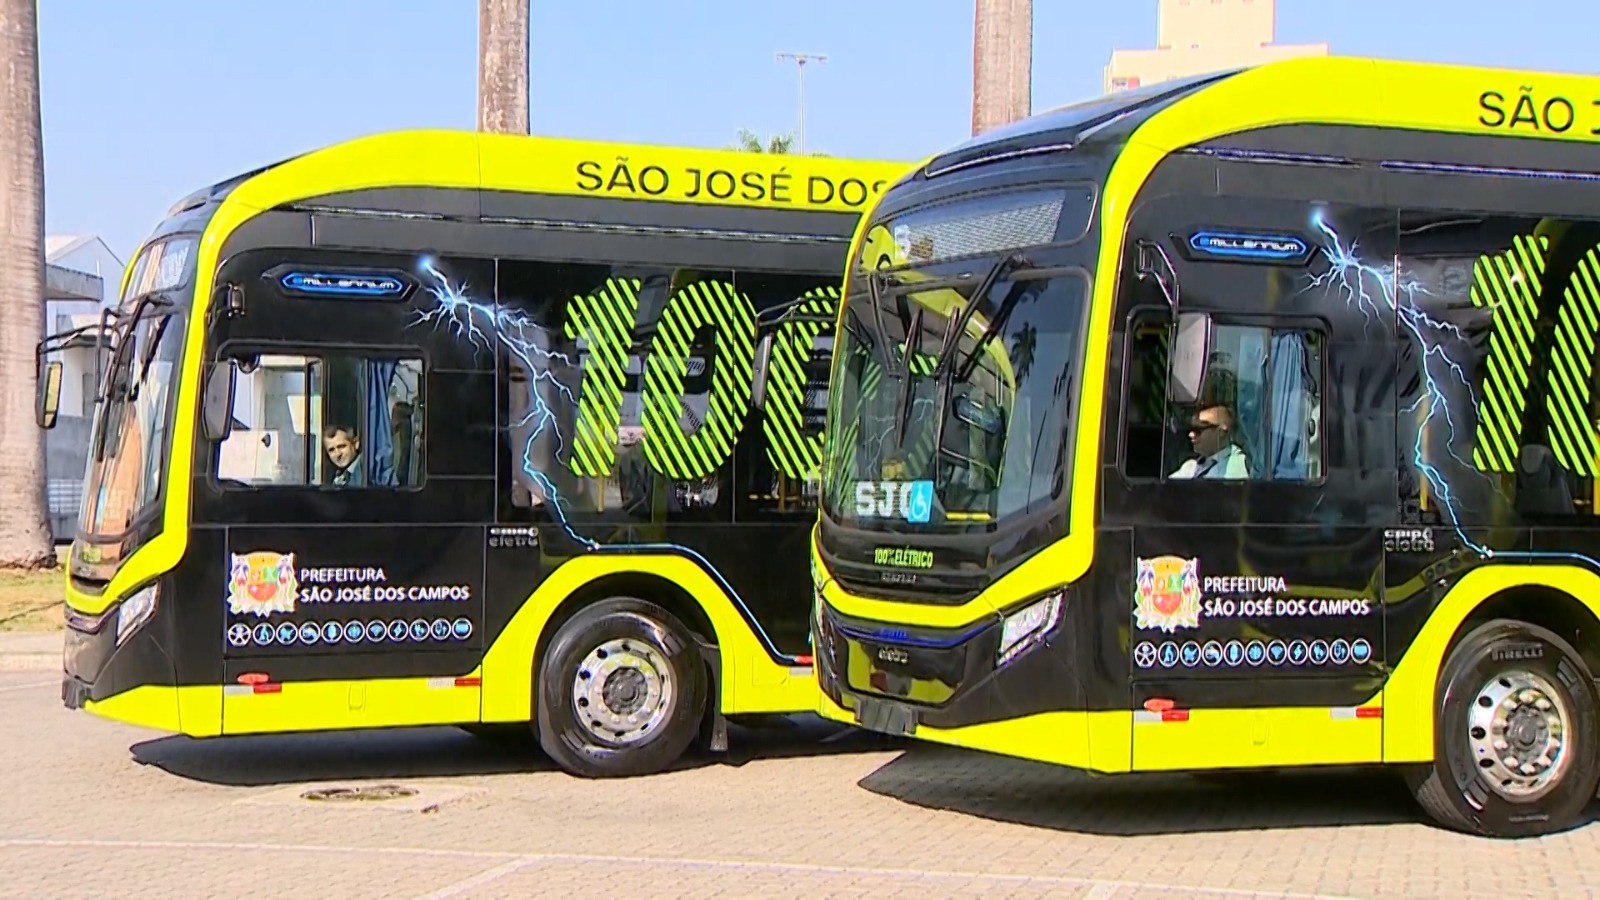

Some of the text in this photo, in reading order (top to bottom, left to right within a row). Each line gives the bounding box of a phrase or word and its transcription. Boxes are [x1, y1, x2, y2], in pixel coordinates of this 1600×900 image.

[1479, 85, 1575, 133] SÃO
[576, 156, 669, 196] SÃO
[684, 166, 793, 203] JOSÉ
[895, 545, 934, 569] ELÉTRICO
[300, 566, 387, 583] PREFEITURA
[1203, 576, 1288, 593] PREFEITURA
[300, 584, 471, 603] SÃO JOSÉ DOS CAMPOS
[1203, 597, 1371, 617] SÃO JOSÉ DOS CAMPOS
